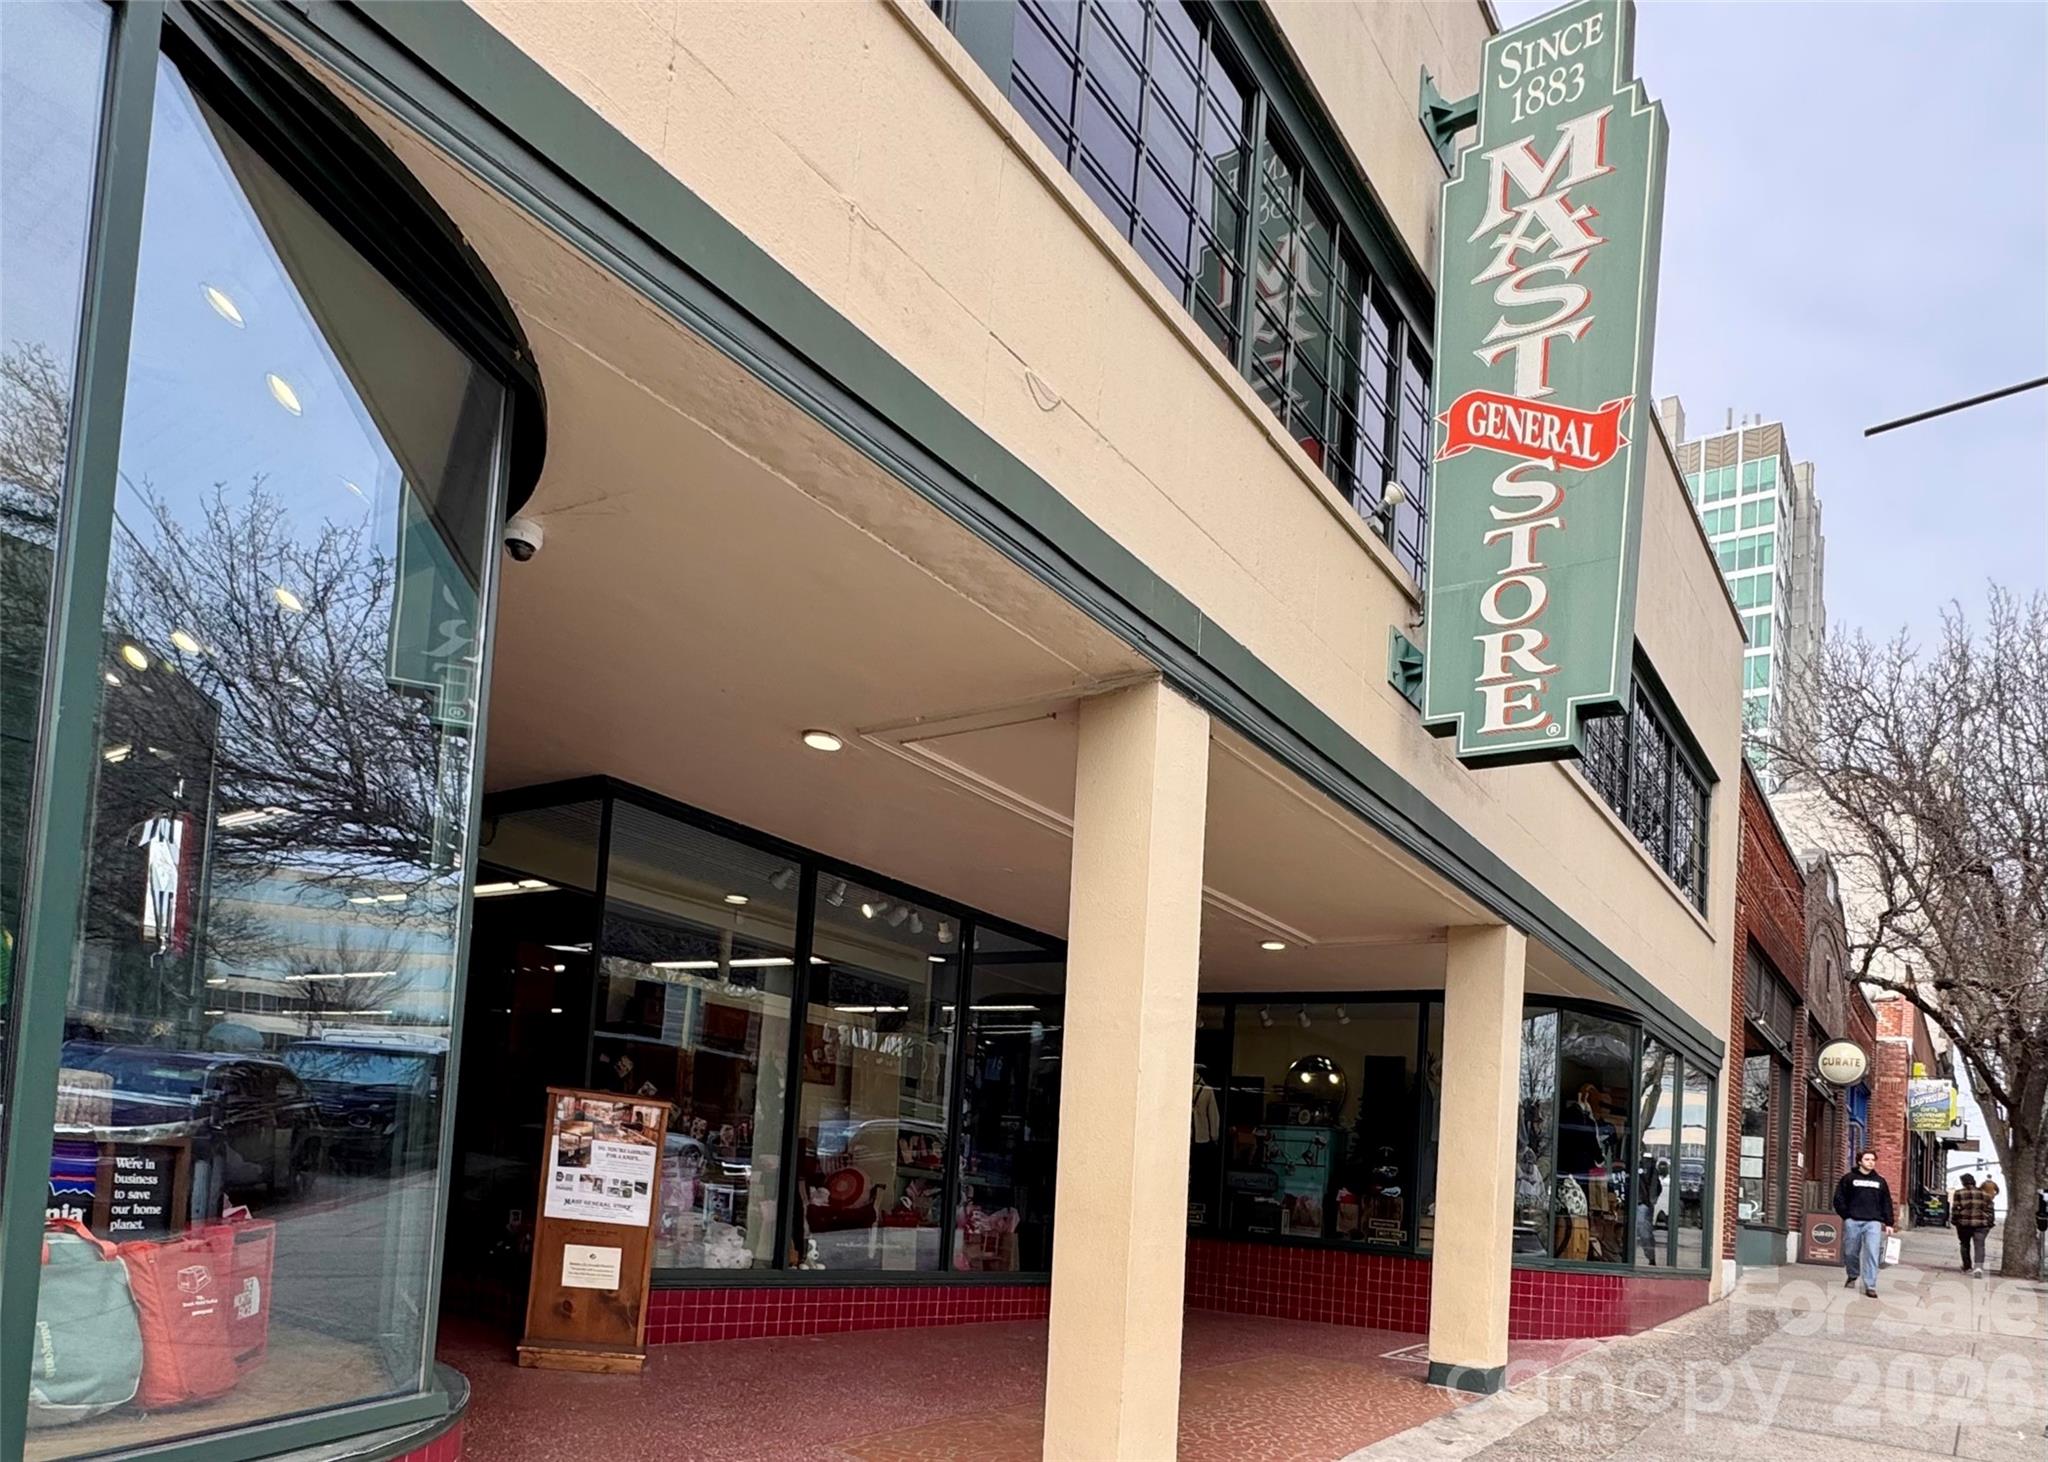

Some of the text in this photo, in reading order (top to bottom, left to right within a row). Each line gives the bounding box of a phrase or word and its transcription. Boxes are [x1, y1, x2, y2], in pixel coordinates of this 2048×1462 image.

[1498, 12, 1604, 89] SINCE
[1511, 63, 1586, 124] 1883
[1467, 105, 1616, 401] MAST
[1466, 400, 1600, 461] GENERAL
[1473, 456, 1565, 737] STORE
[114, 1172, 158, 1185] business
[145, 1158, 155, 1170] in
[111, 1203, 162, 1215] our home
[114, 1190, 151, 1200] to save
[110, 1219, 145, 1232] planet.
